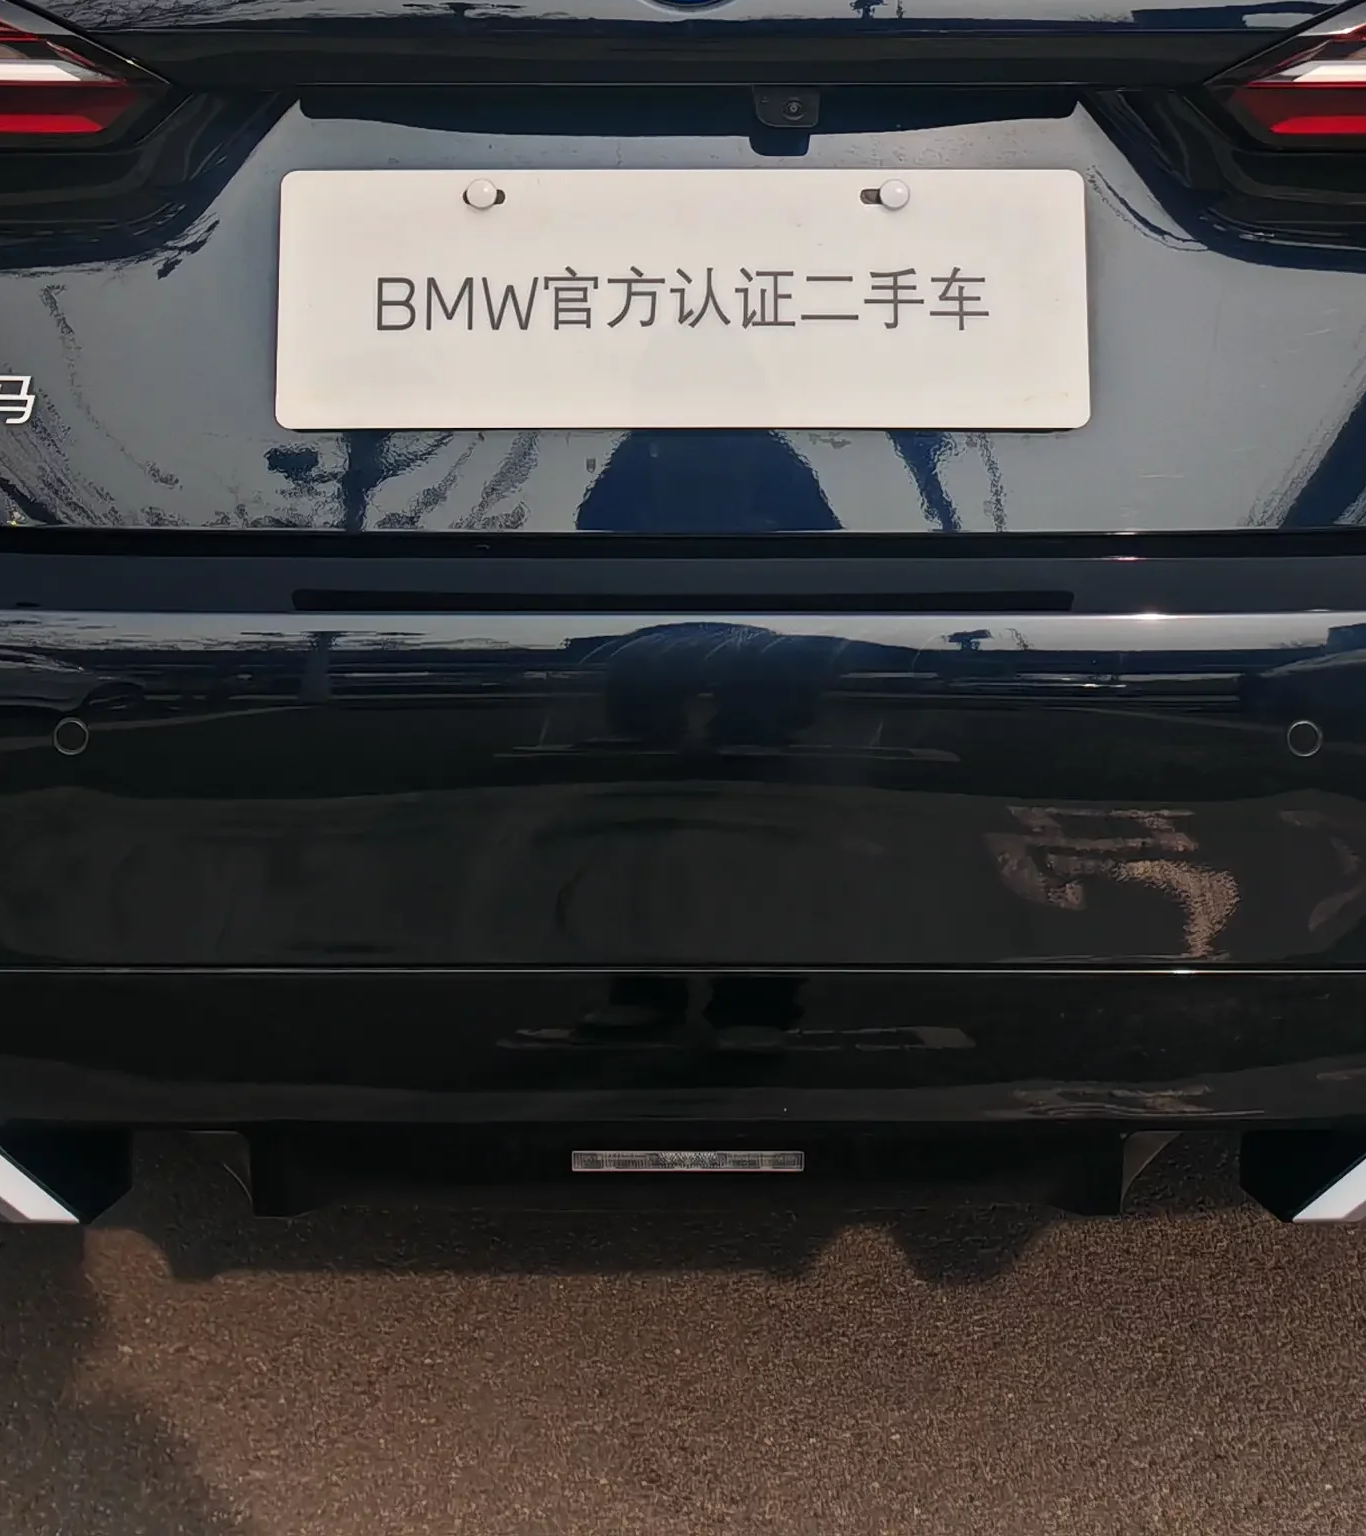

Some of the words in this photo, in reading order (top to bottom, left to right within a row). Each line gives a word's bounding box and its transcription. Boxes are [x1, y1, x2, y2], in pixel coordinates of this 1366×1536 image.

[376, 267, 991, 332] BMW官方认证二手车
